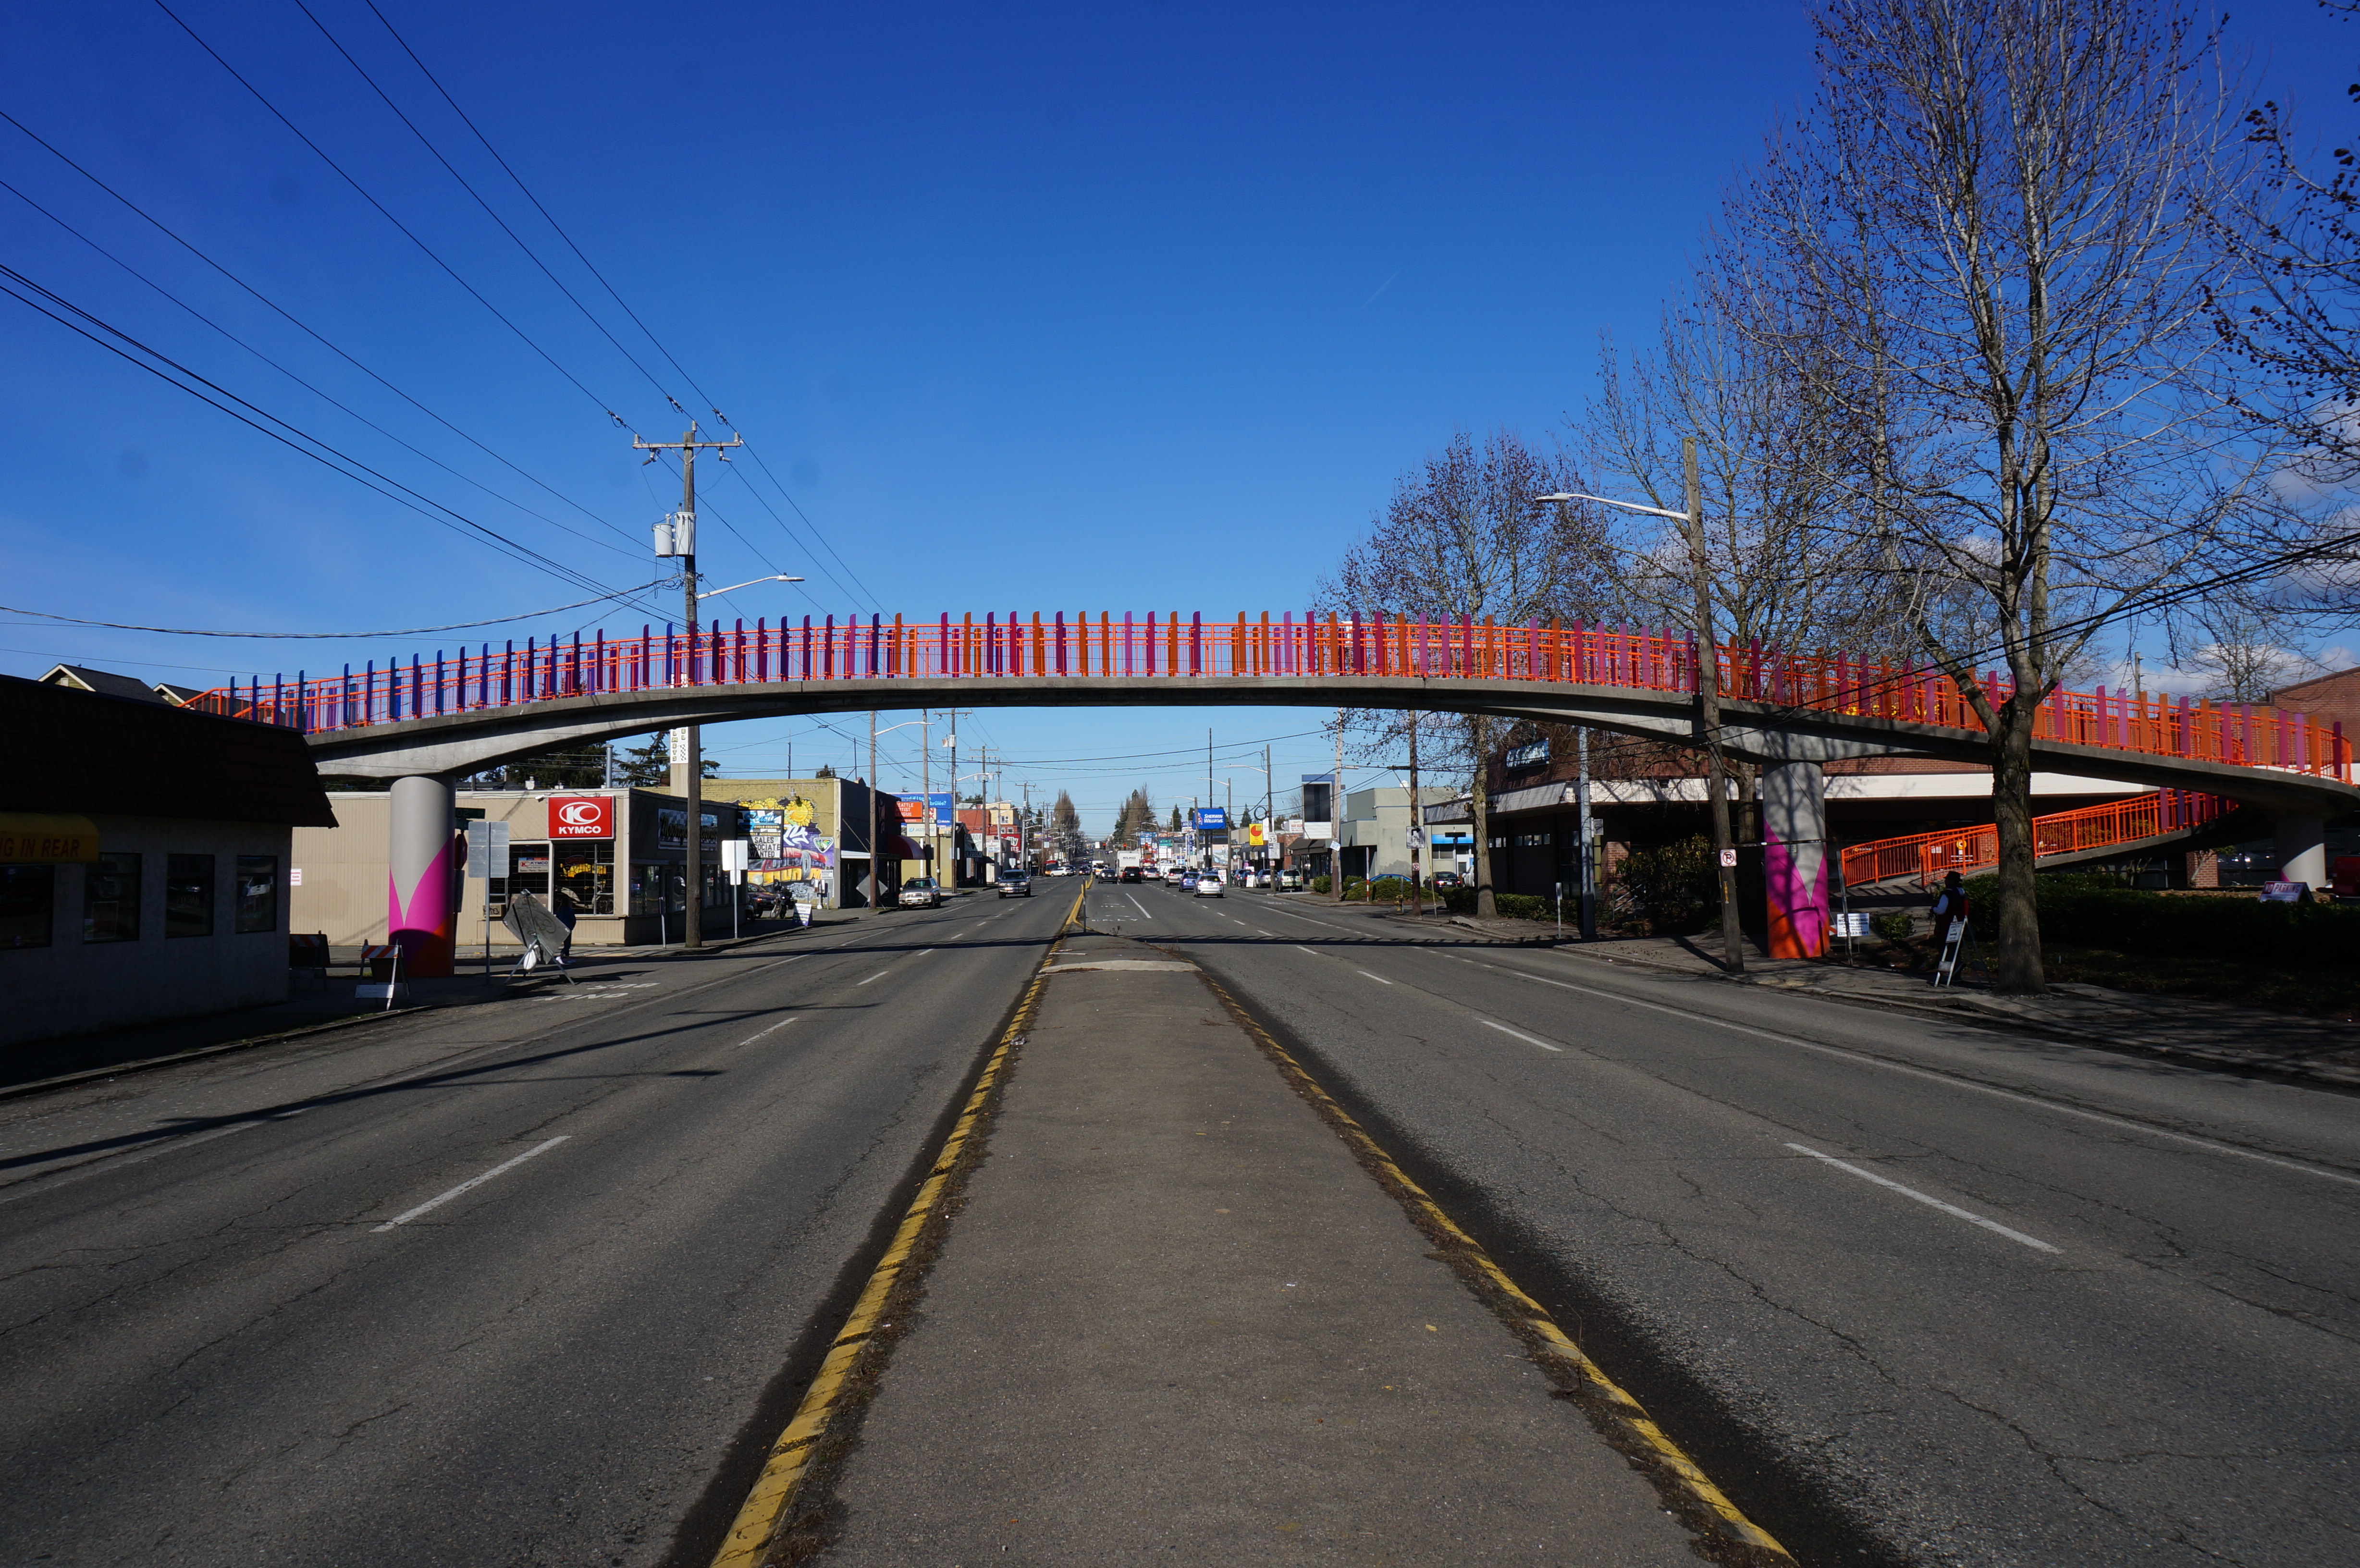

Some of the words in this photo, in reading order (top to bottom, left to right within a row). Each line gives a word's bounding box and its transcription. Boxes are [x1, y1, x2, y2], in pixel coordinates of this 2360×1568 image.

[558, 826, 602, 834] KYMCO
[21, 838, 36, 857] IN
[41, 839, 80, 858] REAR
[2264, 884, 2273, 893] NO
[2275, 884, 2300, 893] PARKING
